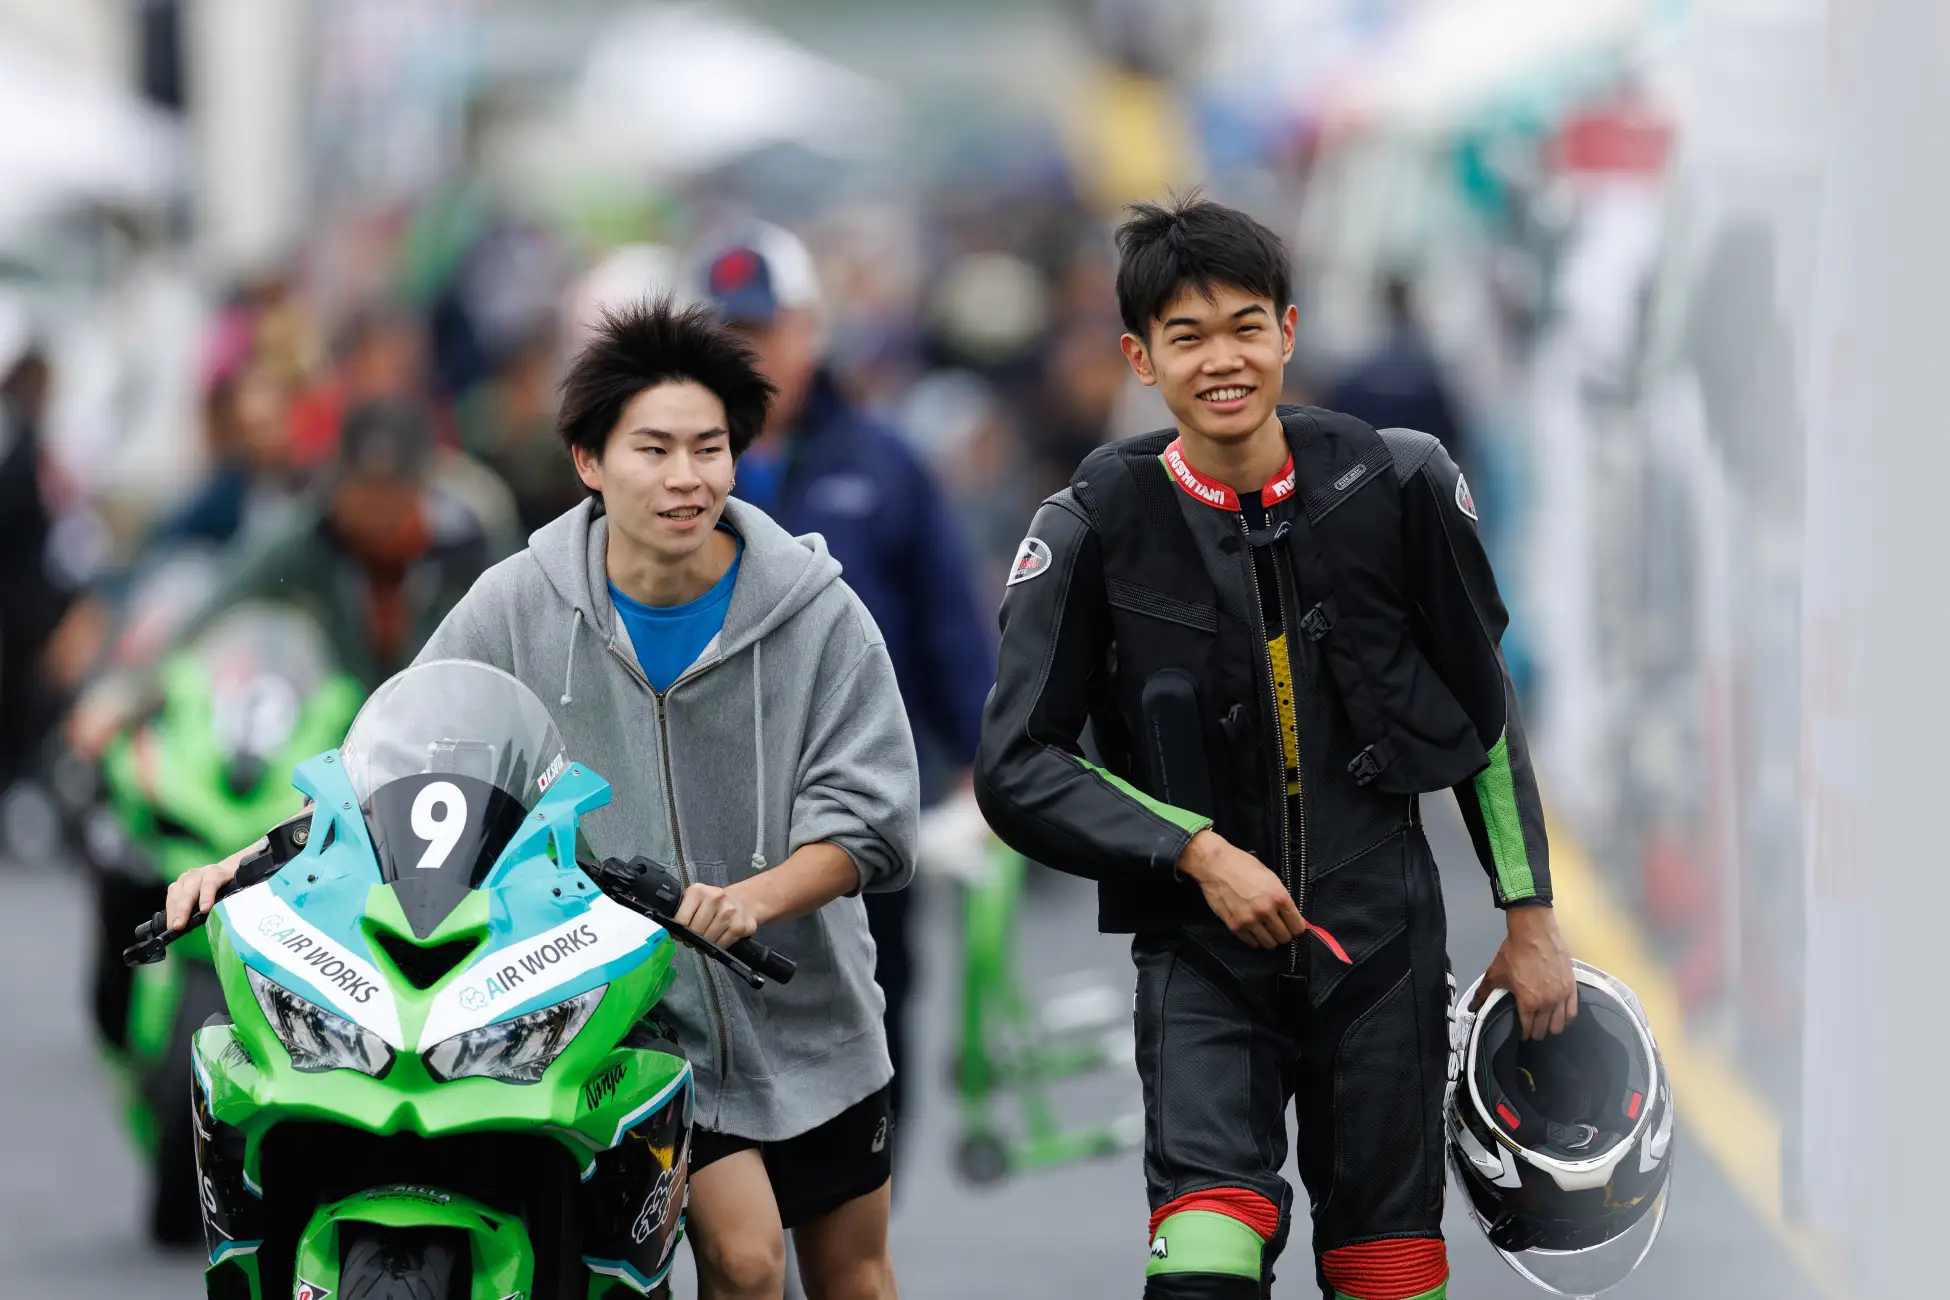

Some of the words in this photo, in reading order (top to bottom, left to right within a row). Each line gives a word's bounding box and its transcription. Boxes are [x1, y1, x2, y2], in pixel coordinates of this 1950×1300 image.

[411, 781, 468, 869] 9
[270, 928, 313, 953] AIR
[302, 946, 380, 1003] WORKS
[485, 965, 525, 1001] AIR
[518, 923, 599, 976] WORKS
[585, 1063, 628, 1112] Ninja
